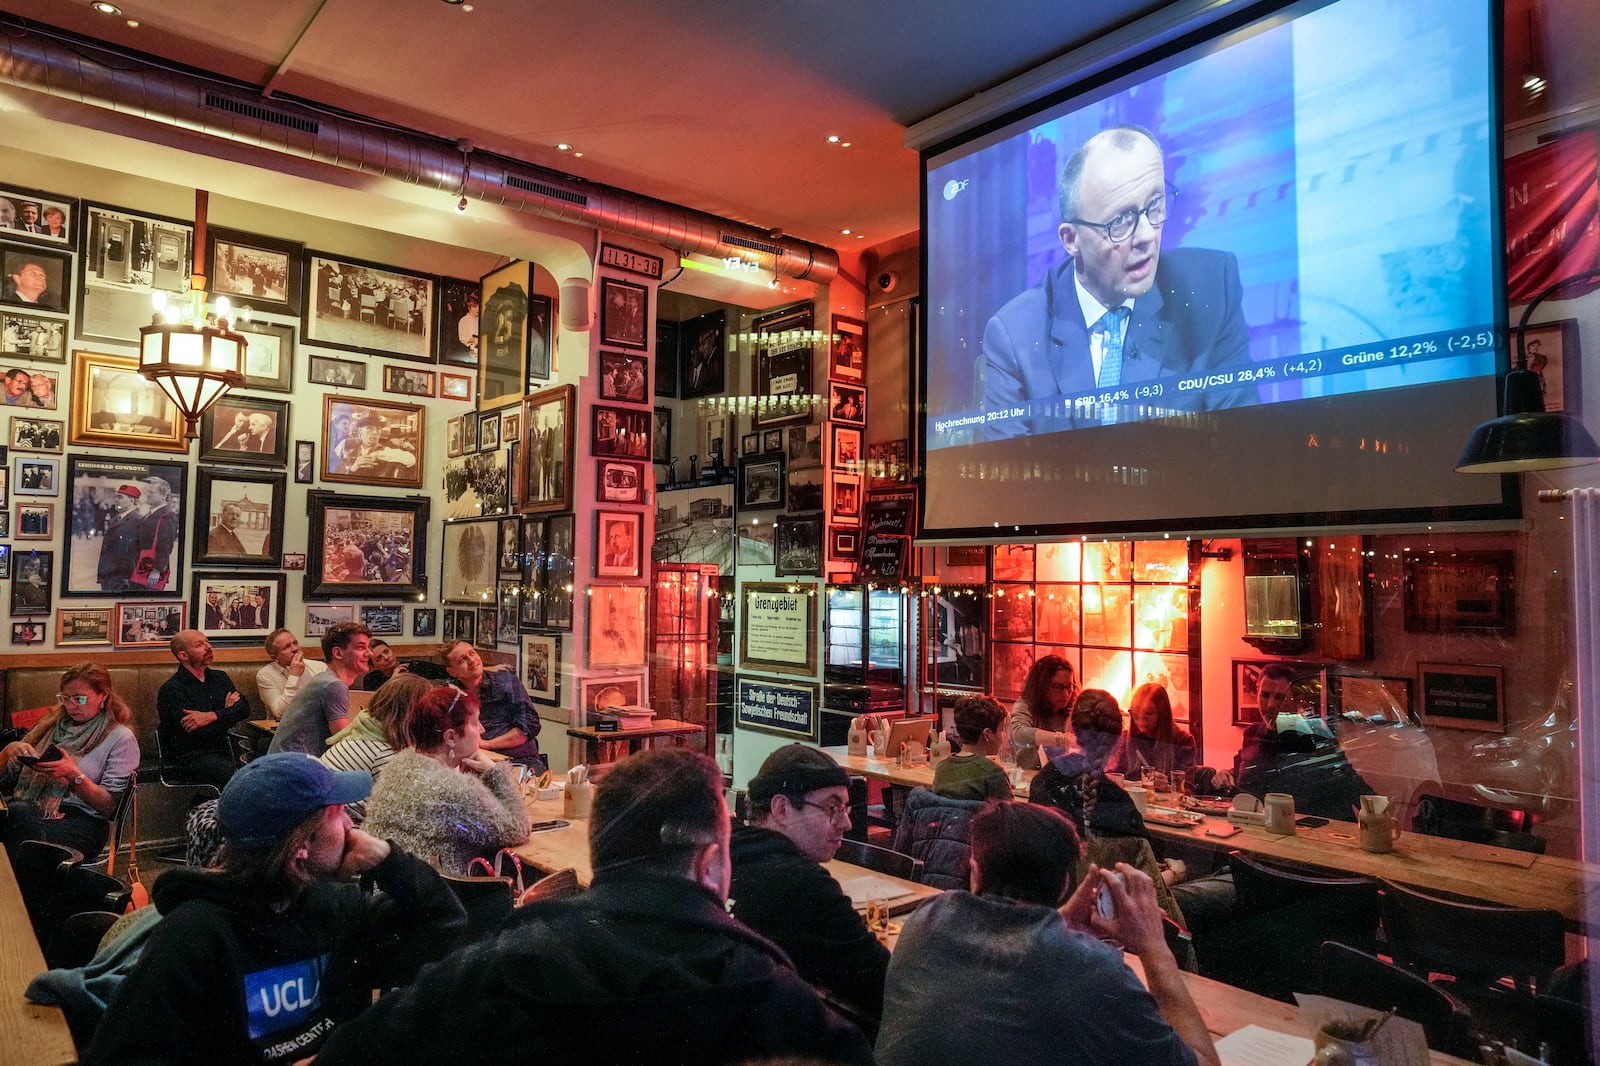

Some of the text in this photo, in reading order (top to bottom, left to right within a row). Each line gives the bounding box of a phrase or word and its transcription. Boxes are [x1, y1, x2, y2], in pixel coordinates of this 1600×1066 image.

[1076, 330, 1494, 407] SPD 16,4% (-9,3) CDU/CSU 28,4% (+4,2) Grüne 12,2% (-2,5)
[935, 407, 1025, 431] Hochrechnung 20:12 Uhr
[755, 596, 798, 613] Grenzgebiet
[749, 688, 765, 703] Straße
[766, 691, 776, 704] der
[742, 702, 808, 725] Sowjetischen Freundschaft
